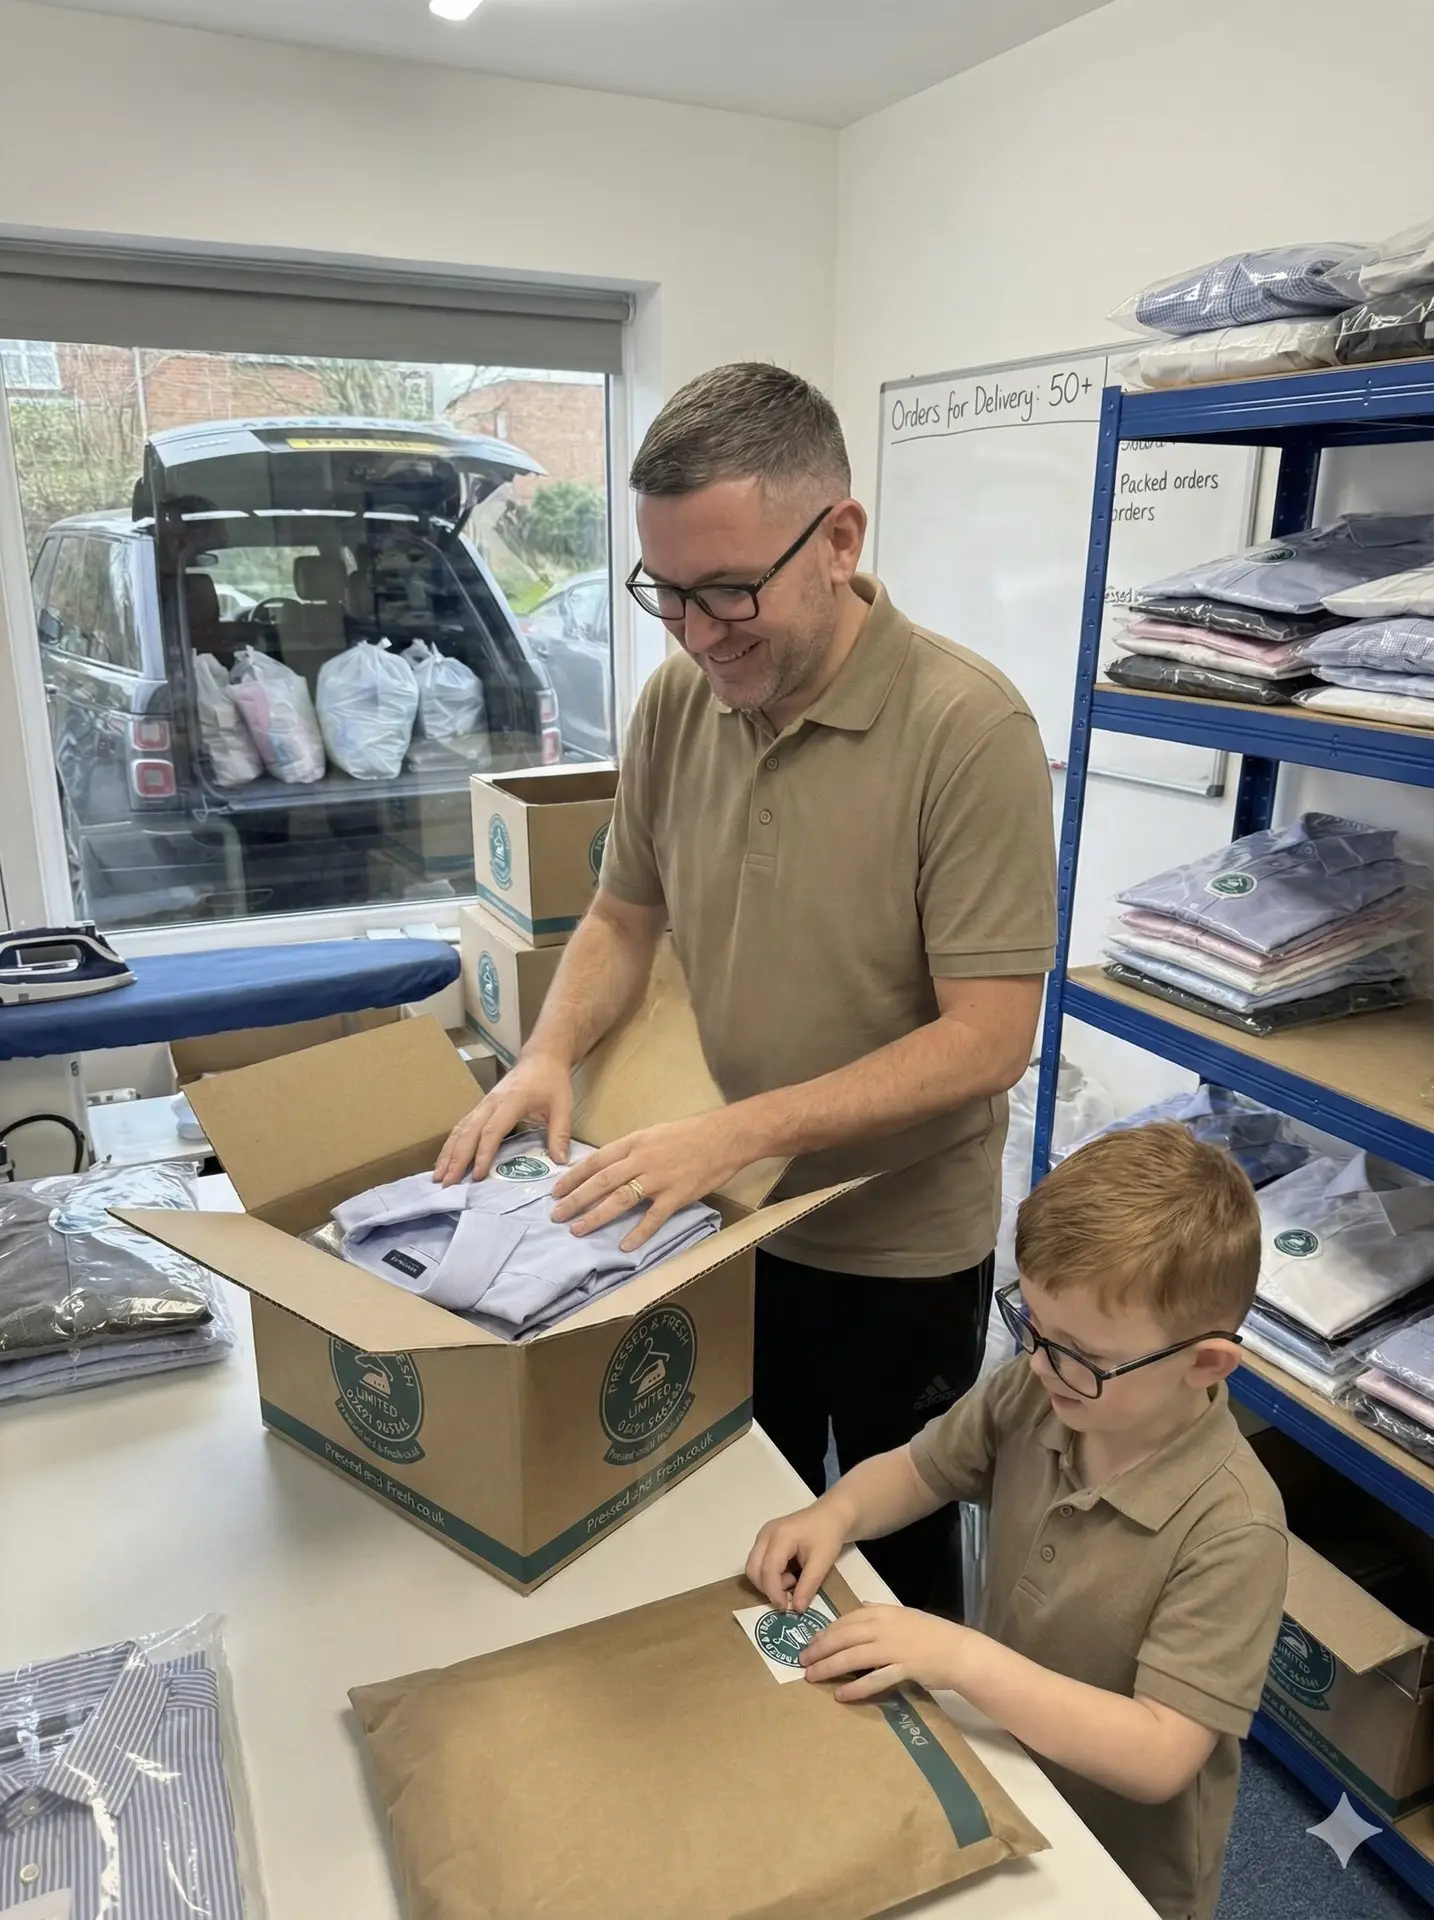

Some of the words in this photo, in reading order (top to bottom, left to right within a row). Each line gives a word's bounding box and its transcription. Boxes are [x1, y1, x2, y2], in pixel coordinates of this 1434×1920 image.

[891, 397, 940, 431] Orders
[947, 390, 969, 429] for
[974, 383, 1040, 422] Delivery:
[1048, 371, 1093, 407] 50+
[1120, 470, 1168, 495] Packed
[1173, 469, 1219, 490] orders
[1111, 501, 1156, 522] orders
[608, 1325, 649, 1395] PRESSED
[650, 1315, 660, 1331] &
[661, 1314, 690, 1348] FRESH
[628, 1383, 672, 1419] LIMITED
[587, 1491, 630, 1533] Pressed
